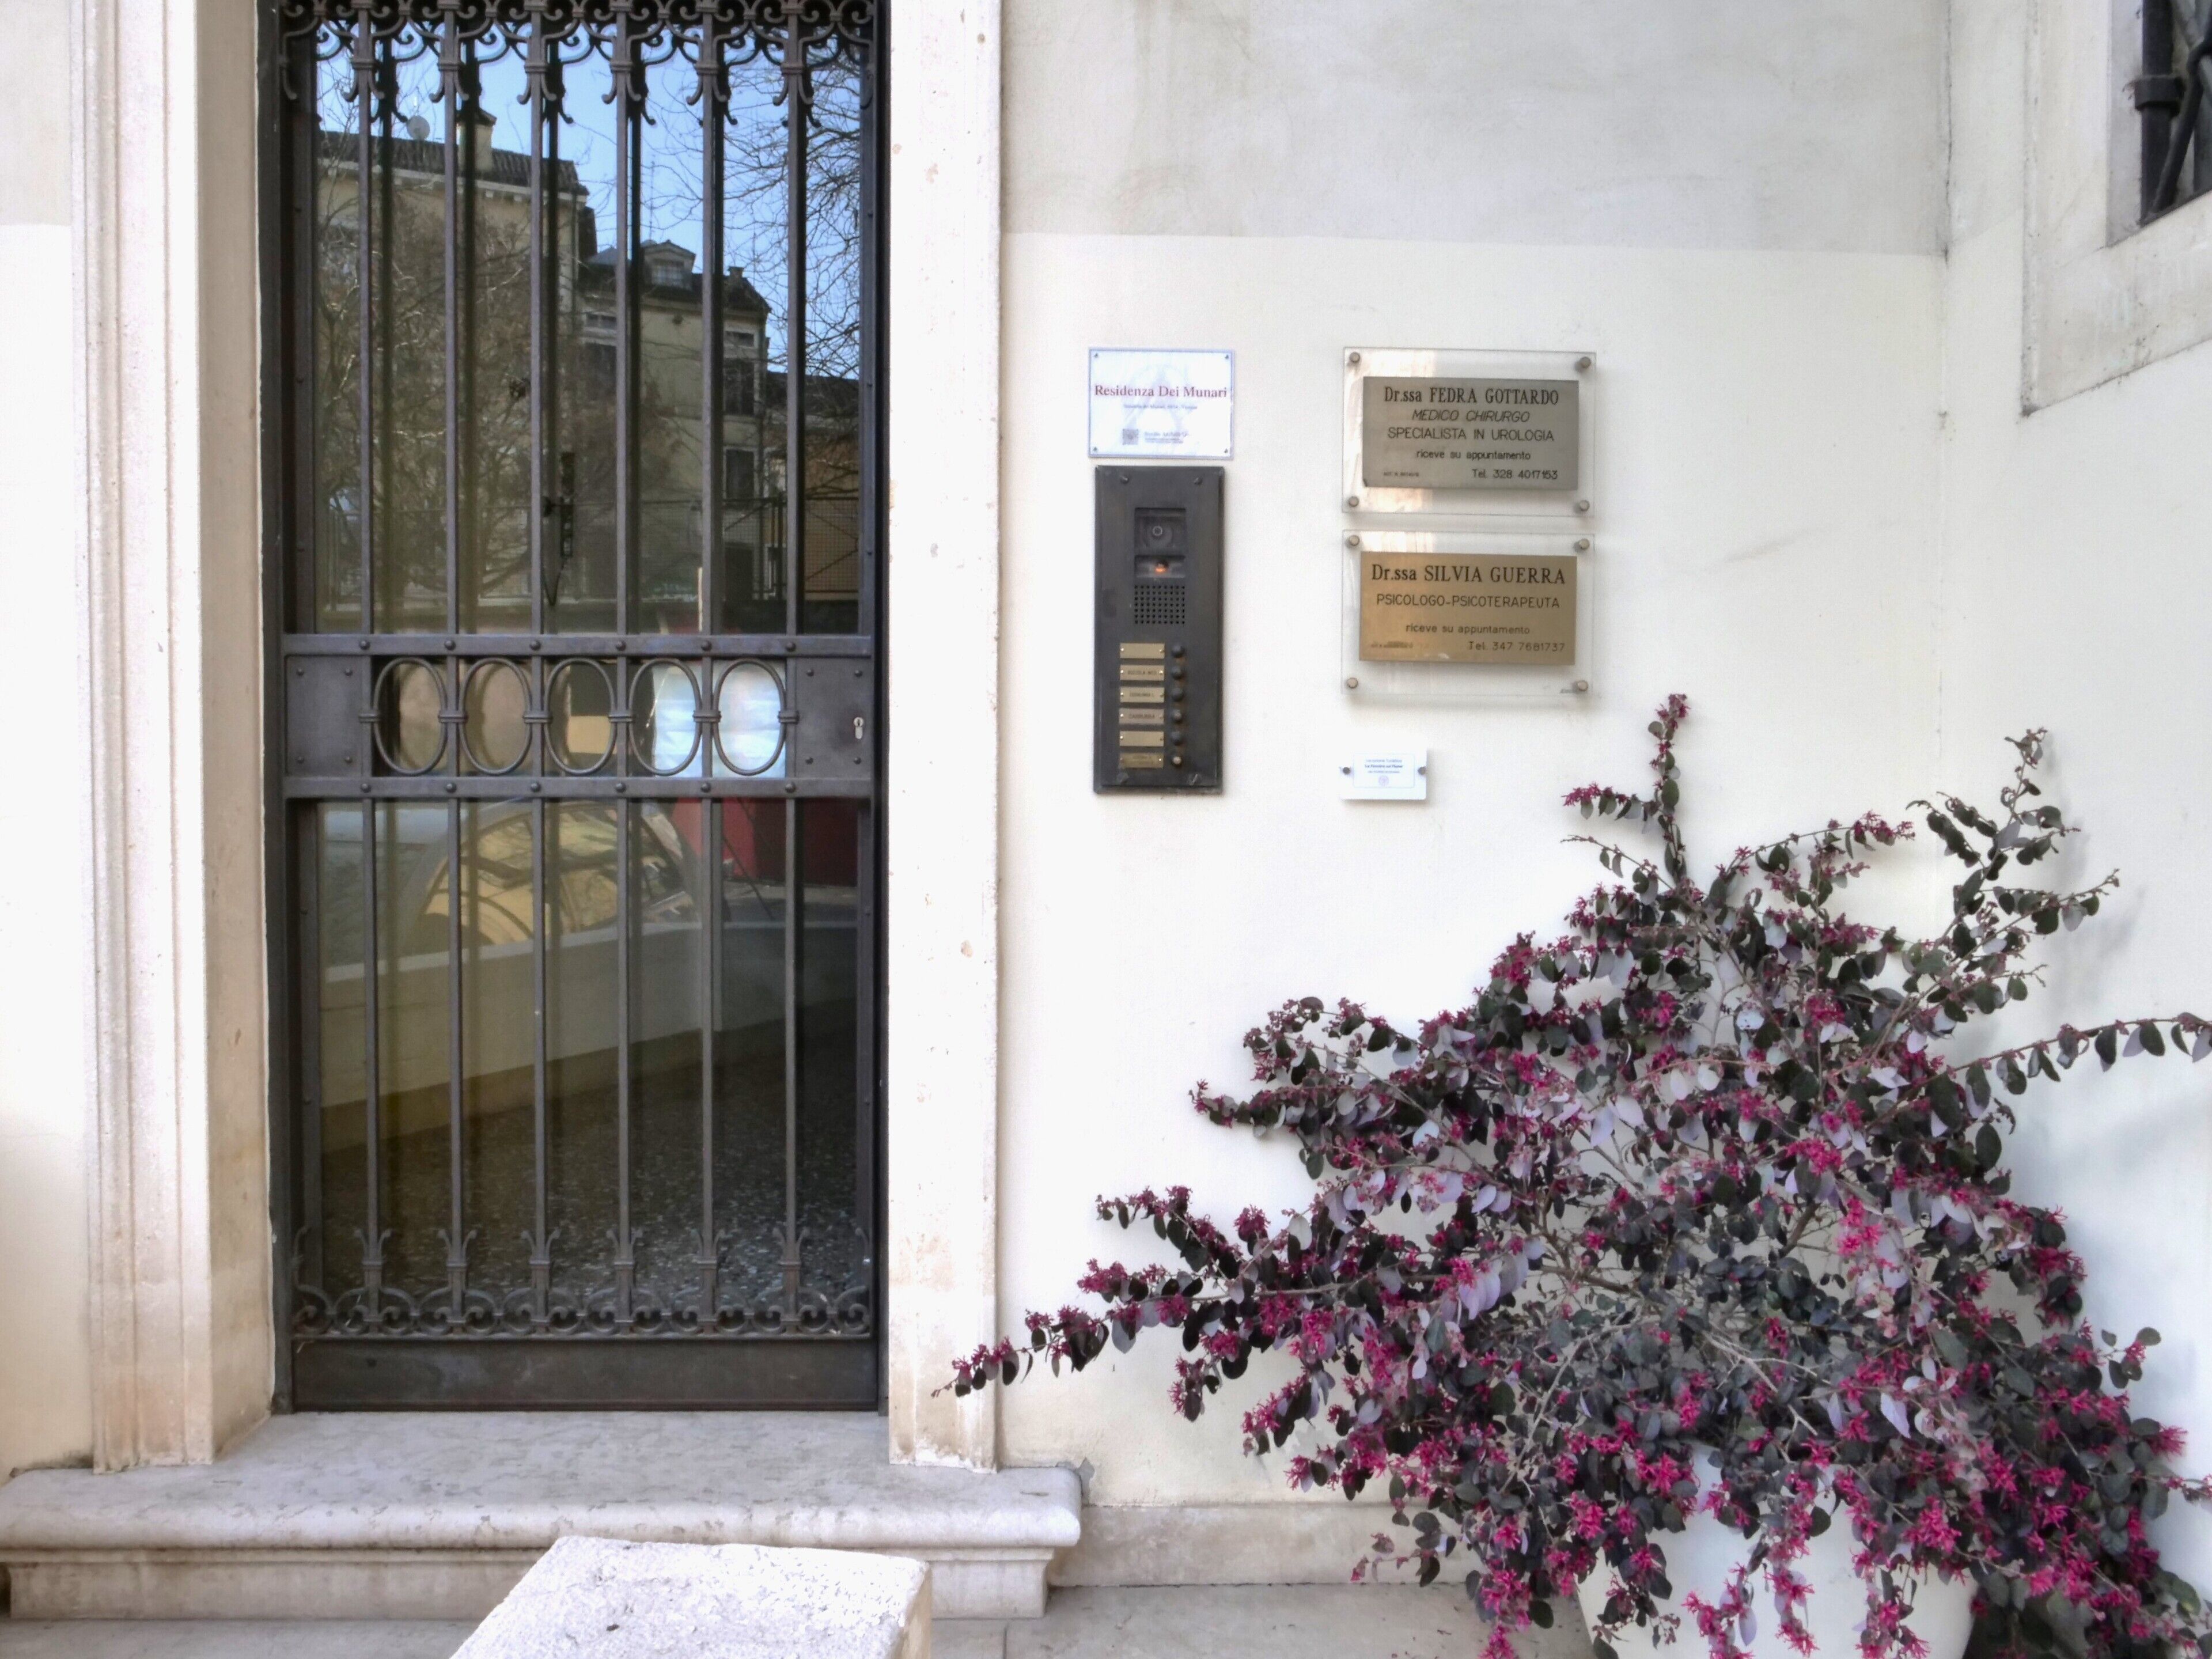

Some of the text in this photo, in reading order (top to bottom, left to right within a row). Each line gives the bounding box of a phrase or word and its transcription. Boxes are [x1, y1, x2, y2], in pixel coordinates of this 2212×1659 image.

[1094, 385, 1227, 397] Residenza Dei Munari
[1384, 387, 1559, 405] Dr.ssa FEDRA GOTTARDO
[1412, 410, 1530, 422] MEDICO CHIRURGO
[1387, 427, 1555, 441] SPECIALISTA IN UROLOGIA
[1416, 449, 1445, 459] riceve
[1466, 450, 1531, 461] appuntamento
[1493, 469, 1513, 479] 328
[1372, 564, 1566, 584] Dr.ssa SILVIA GUERRA
[1377, 593, 1560, 608] PSICOLOGO-PSICOTERAPEUTA
[1406, 623, 1531, 635] riceve su appuntamento
[1493, 641, 1513, 652] 347
